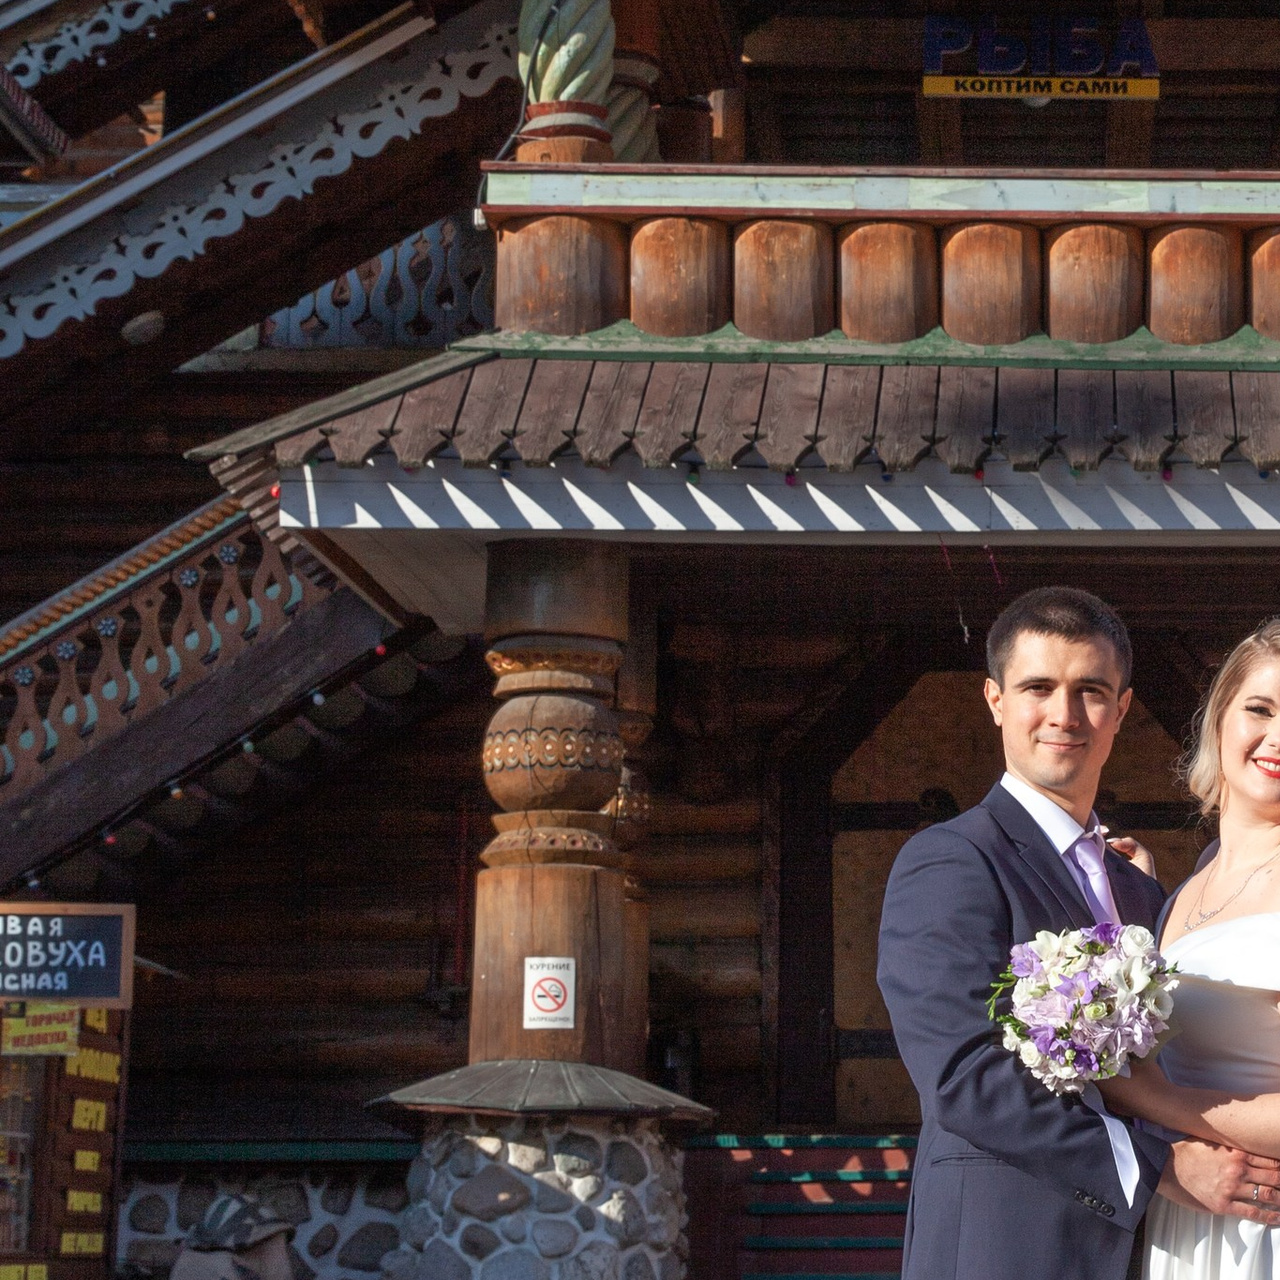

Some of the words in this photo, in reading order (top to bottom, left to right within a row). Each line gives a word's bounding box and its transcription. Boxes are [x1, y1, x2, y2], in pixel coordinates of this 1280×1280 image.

[923, 17, 1160, 76] РЫБА
[954, 79, 1053, 94] КОПТИМ
[1060, 79, 1129, 94] САМИ
[0, 915, 63, 937] ВАЯ
[0, 940, 107, 968] ОВУХА
[529, 963, 571, 971] КУРЕНИЕ
[0, 972, 69, 990] СНАЯ
